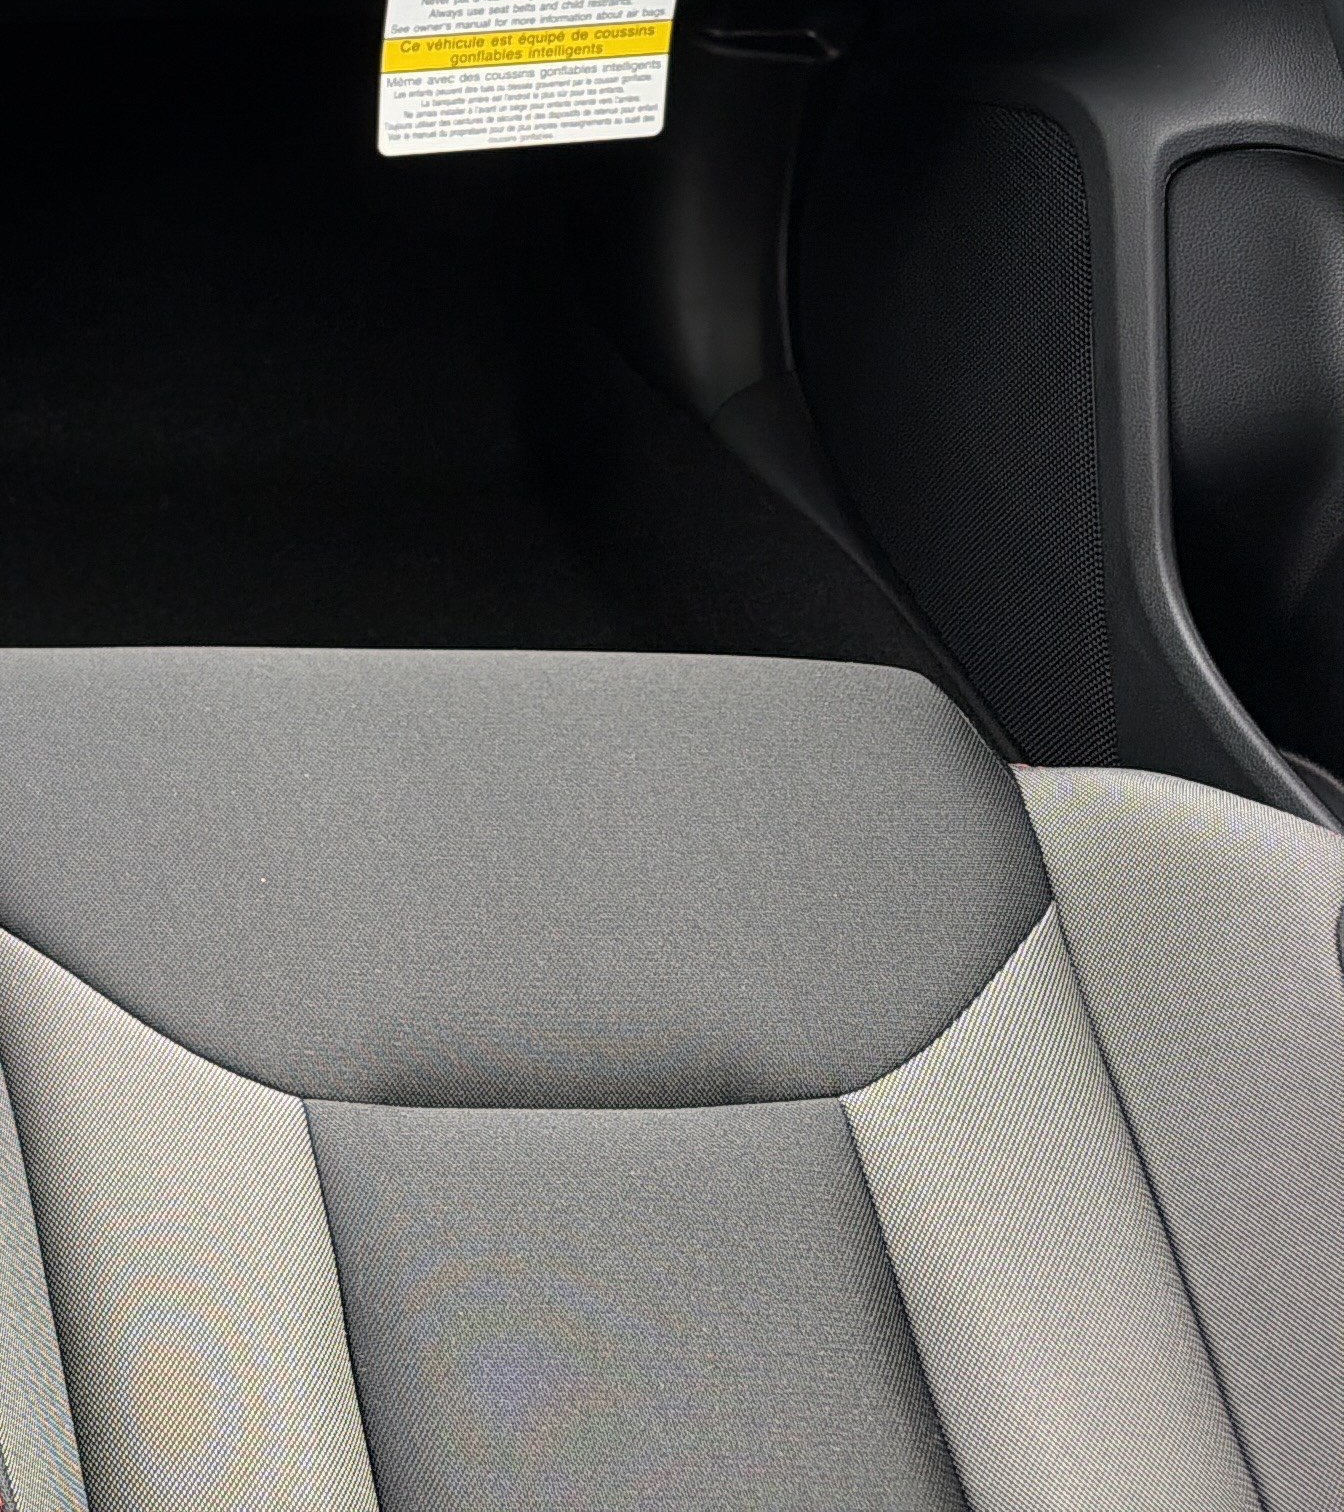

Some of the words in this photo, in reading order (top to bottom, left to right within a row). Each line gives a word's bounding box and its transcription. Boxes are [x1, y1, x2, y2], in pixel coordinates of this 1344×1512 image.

[400, 40, 421, 53] Ce
[426, 35, 485, 51] véhicule
[491, 34, 512, 47] est
[517, 31, 565, 47] équipé
[570, 29, 588, 41] de
[593, 25, 656, 39] coussins
[449, 48, 523, 67] gonflables
[528, 43, 604, 60] intelligents
